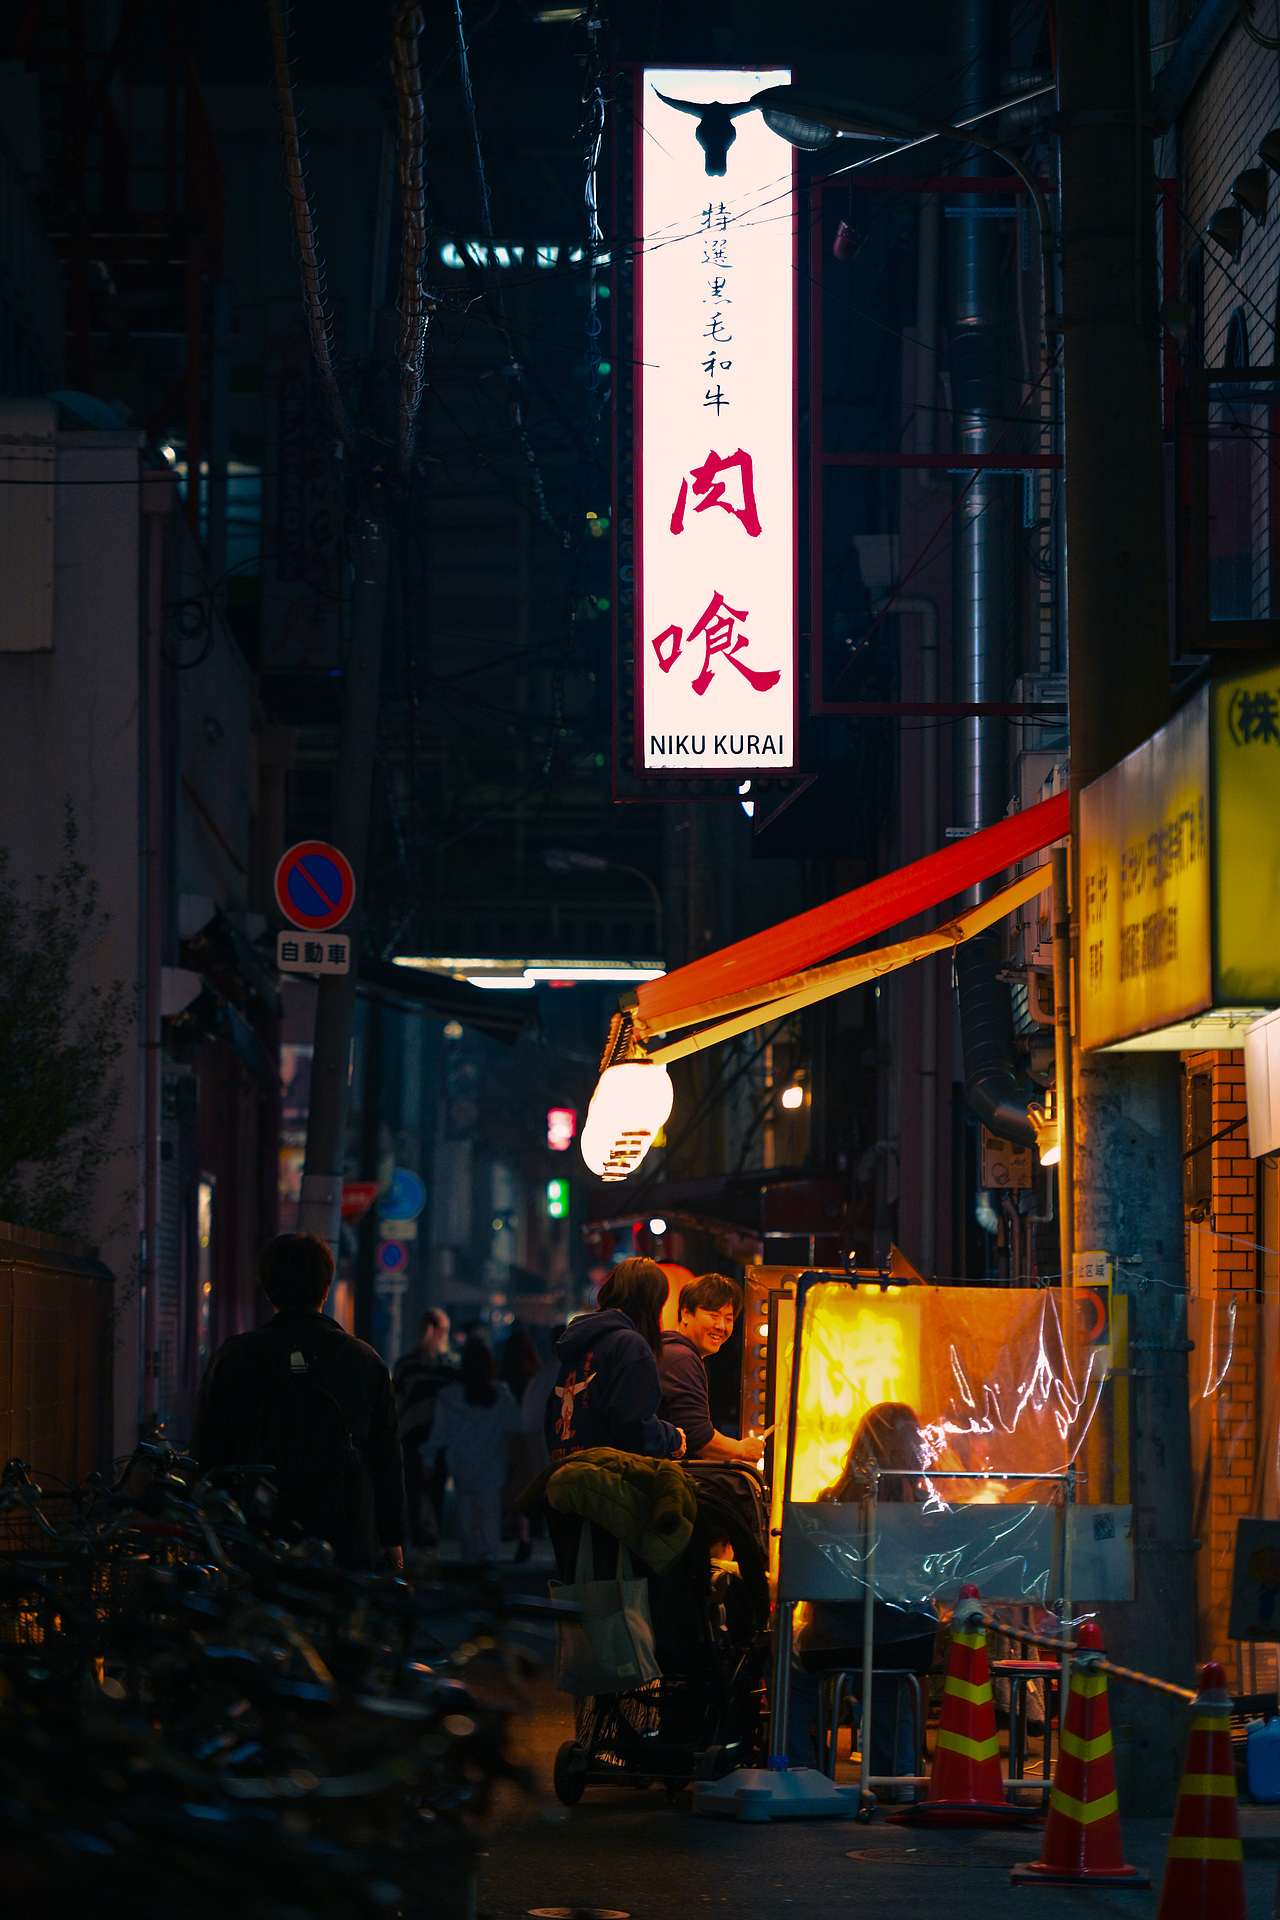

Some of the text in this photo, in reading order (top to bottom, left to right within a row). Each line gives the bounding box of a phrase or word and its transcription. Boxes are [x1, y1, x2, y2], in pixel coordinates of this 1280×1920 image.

[701, 201, 733, 417] 特選黒毛和牛
[651, 448, 782, 696] 肉喰
[651, 735, 783, 756] NIKU KURAI
[1229, 689, 1280, 747] (株
[282, 941, 347, 965] 自動車
